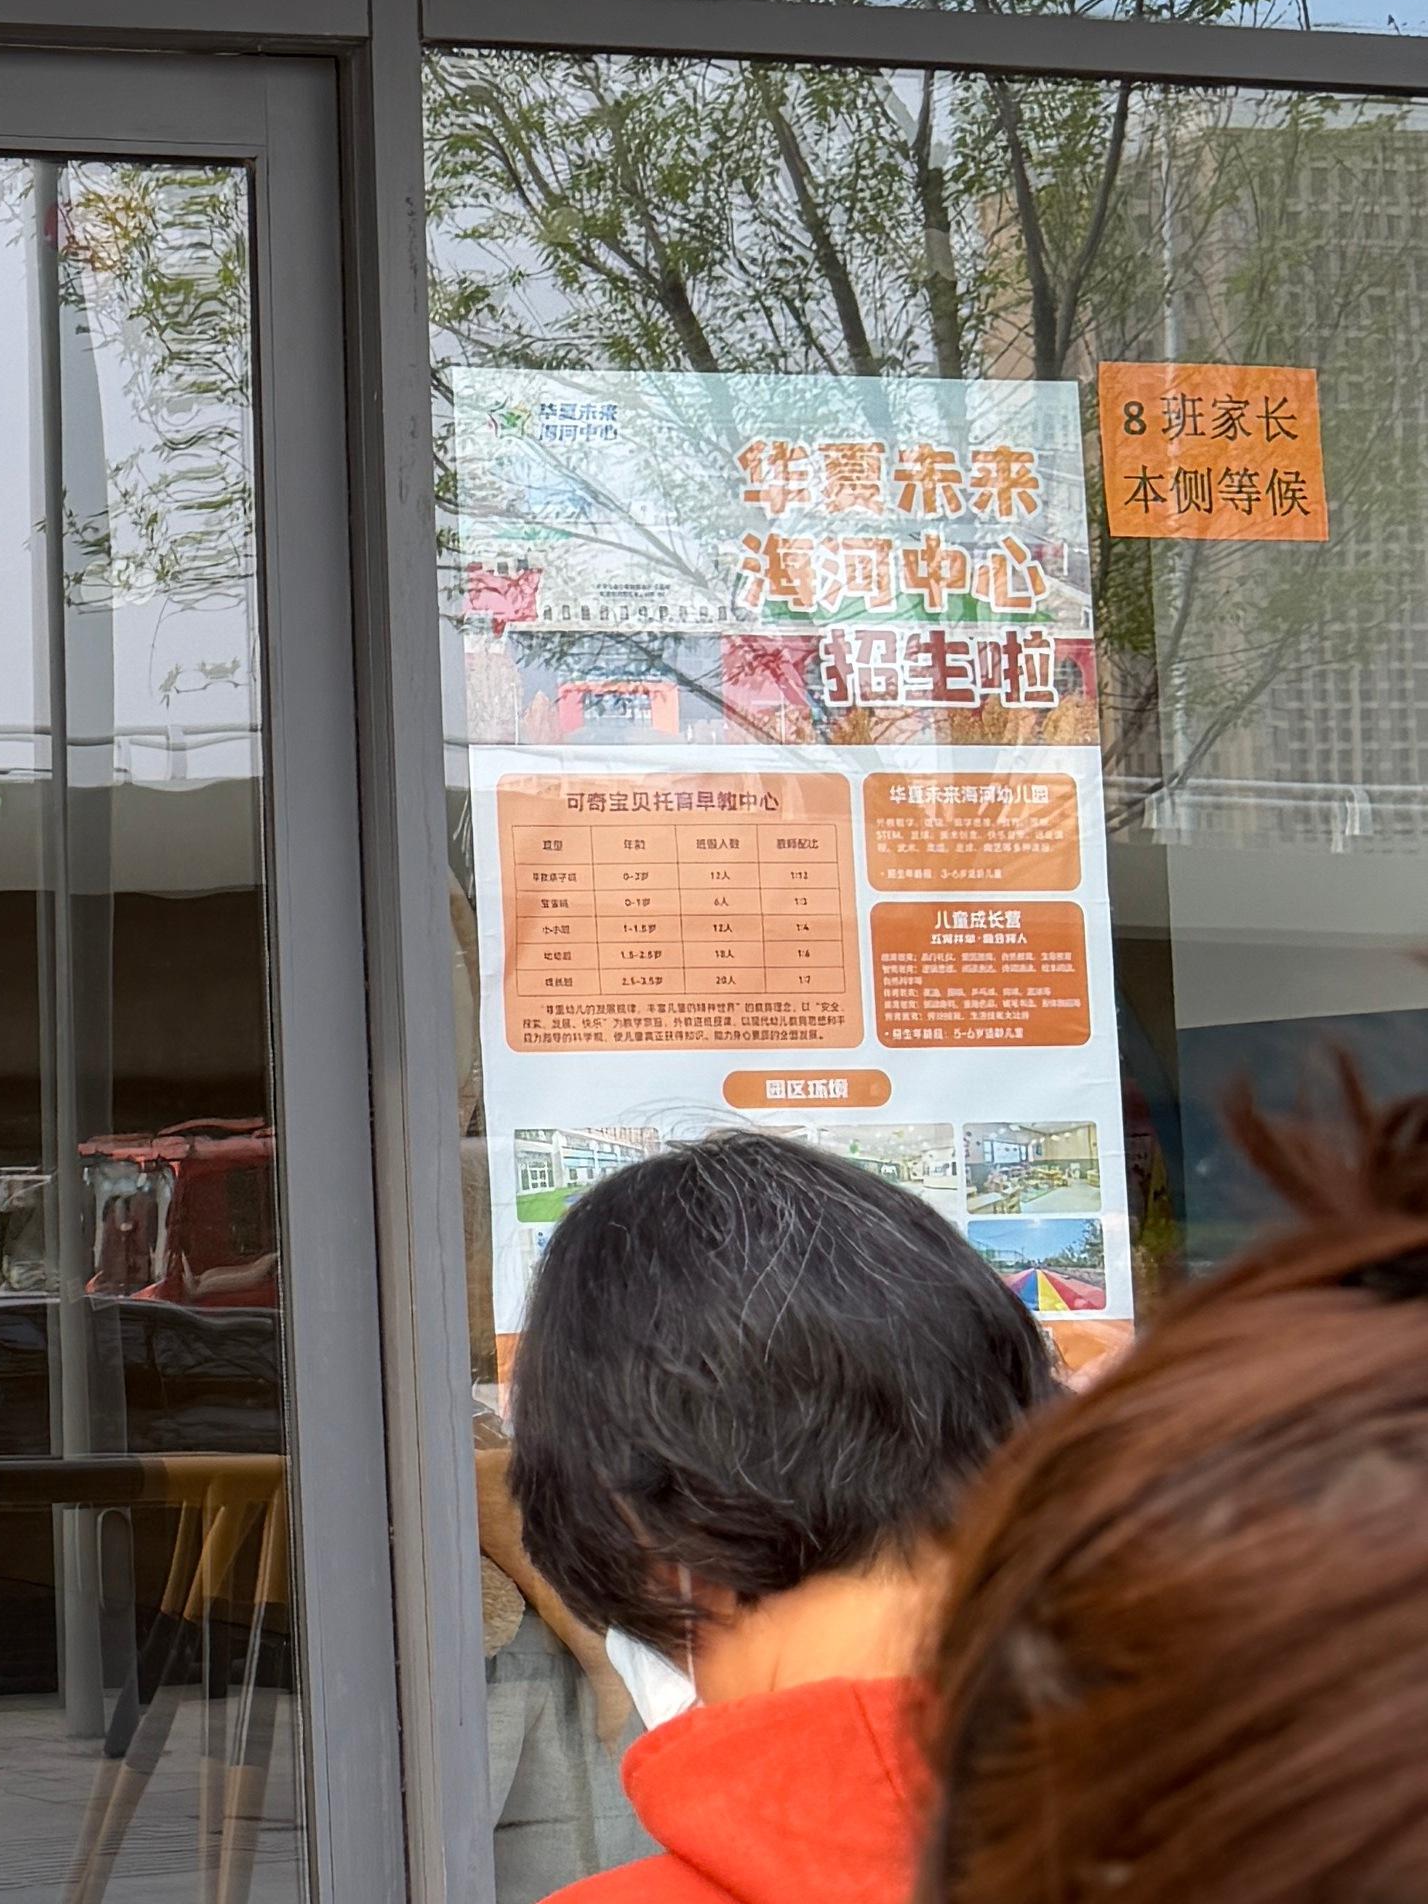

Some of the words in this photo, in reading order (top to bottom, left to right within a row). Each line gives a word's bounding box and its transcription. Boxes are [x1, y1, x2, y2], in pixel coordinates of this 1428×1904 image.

[737, 440, 1040, 517] 华夏未来
[1123, 465, 1311, 517] 本侧等候
[741, 533, 1048, 610] 海河中心
[823, 628, 1056, 703] 招生啦
[565, 791, 780, 812] 可奇宝贝托育早教中心
[889, 784, 1049, 804] 华夏未来海河幼儿园
[934, 910, 1022, 929] 儿童成长营
